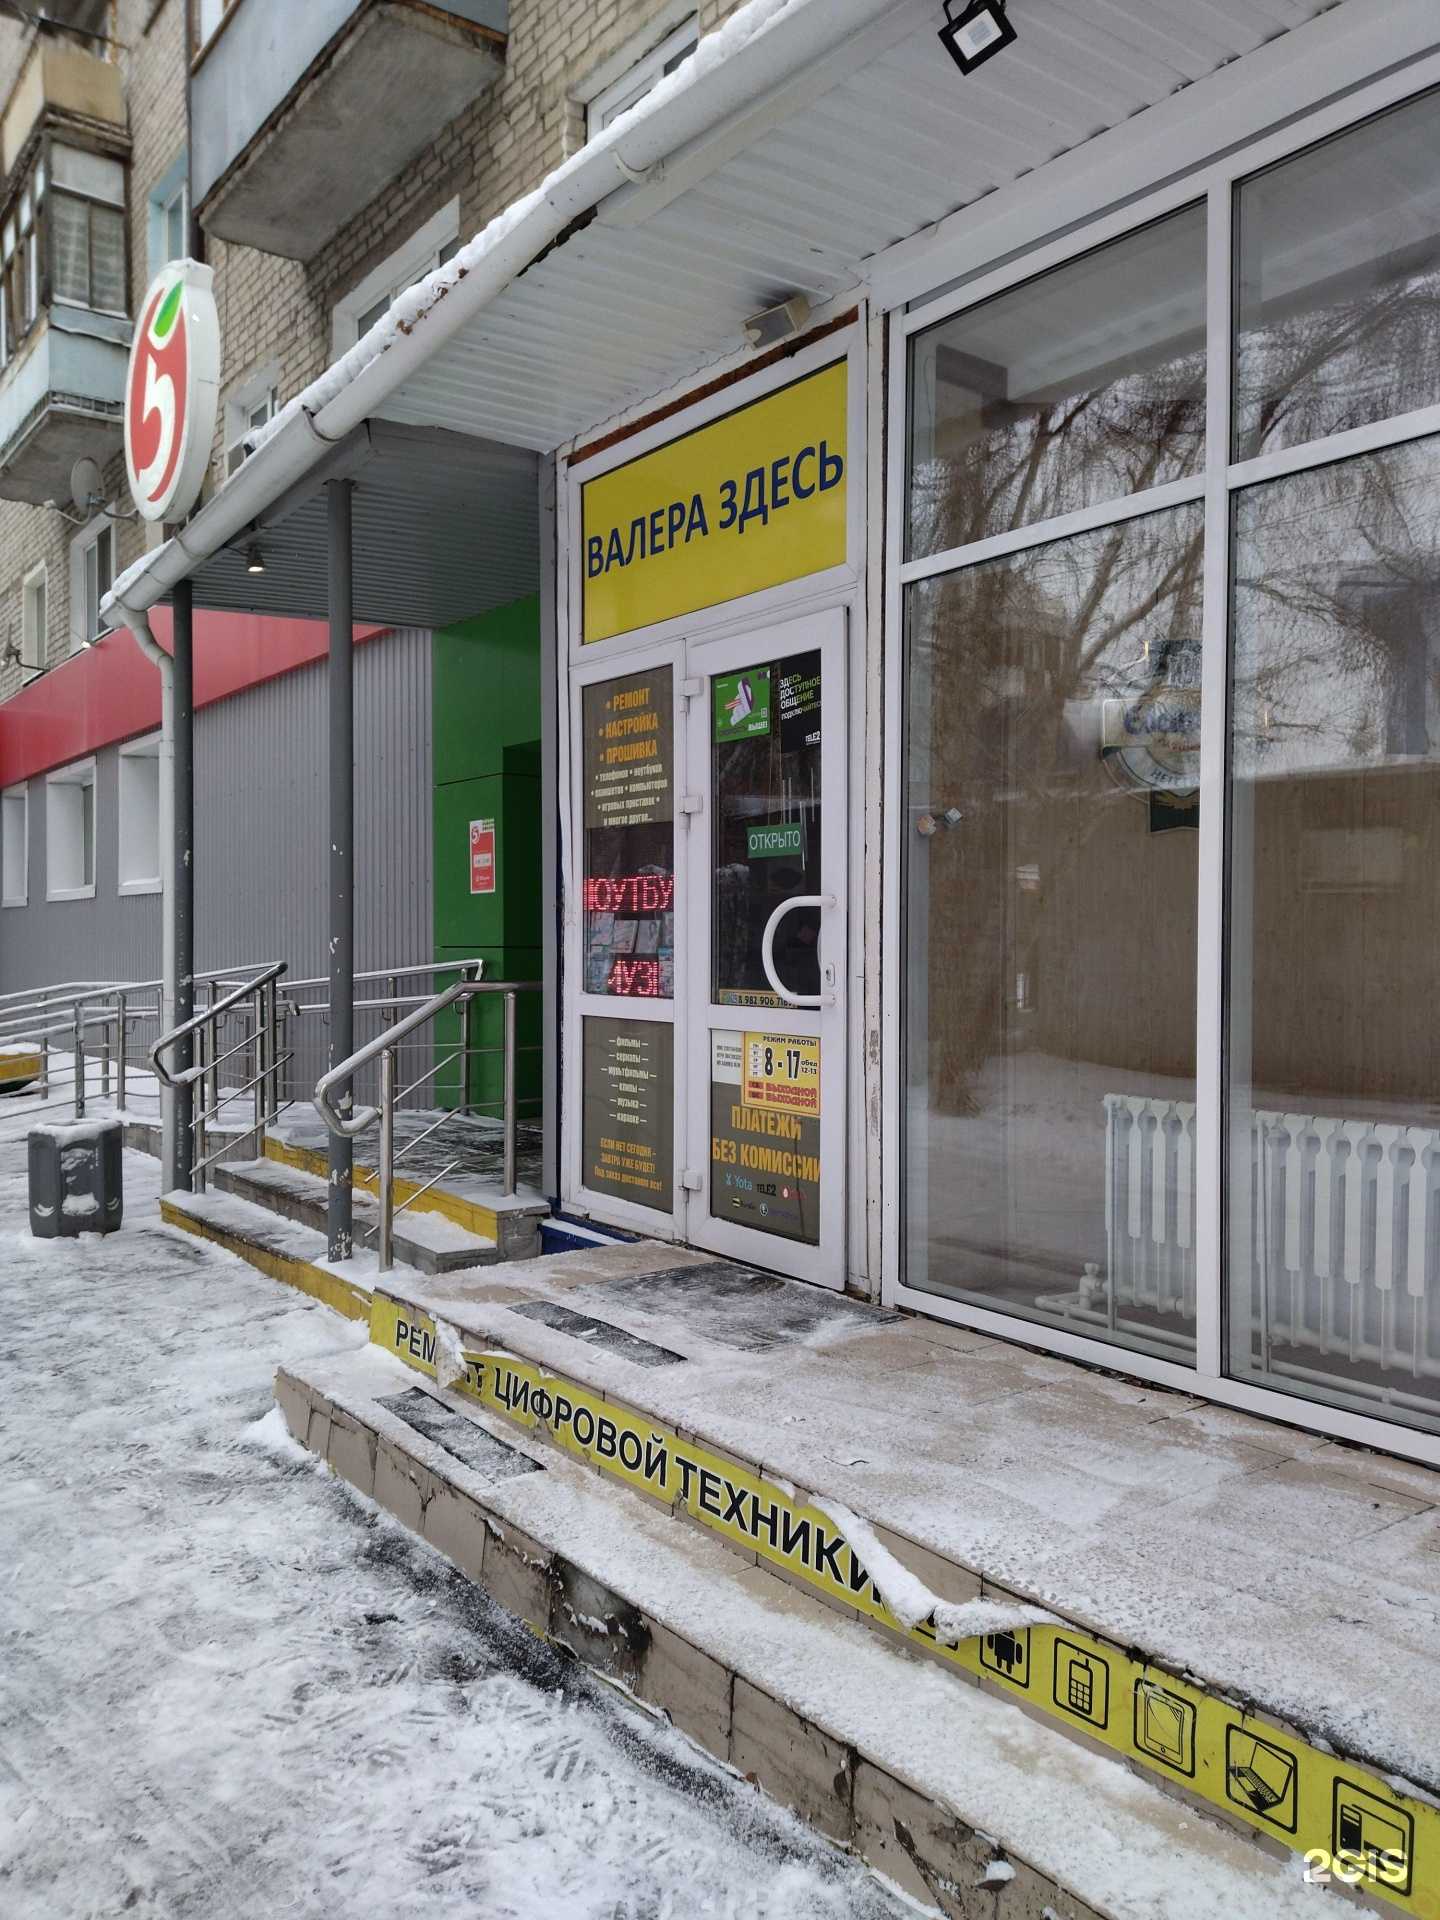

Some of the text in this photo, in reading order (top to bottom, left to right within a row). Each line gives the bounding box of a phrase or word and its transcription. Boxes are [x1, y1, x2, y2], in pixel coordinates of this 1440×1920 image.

[588, 440, 844, 578] ВАЛЕРА ЗДЕСЬ
[780, 673, 802, 689] ЗДЕСЬ
[780, 676, 821, 700] ДОСТУПНОЕ
[613, 688, 650, 712] РЕМОНТ
[780, 690, 814, 709] ОБЩЕНИЕ
[606, 713, 658, 738] НАСТРОЙКА
[606, 740, 657, 764] ПРОШИВКА
[749, 830, 801, 850] ОТКРЫТО
[762, 1036, 817, 1047] РЕЖИМ РАБОТЫ
[765, 1047, 773, 1076] 8
[787, 1050, 800, 1079] 17
[731, 1105, 802, 1141] ПЛАТЕЖИ
[712, 1137, 821, 1183] БЕЗ КОМИССИИ
[735, 1175, 753, 1191] Yota
[757, 1183, 777, 1194] TELE2
[396, 1319, 485, 1389] РЕМТ
[494, 1367, 668, 1488] ЦИФРОВОЙ
